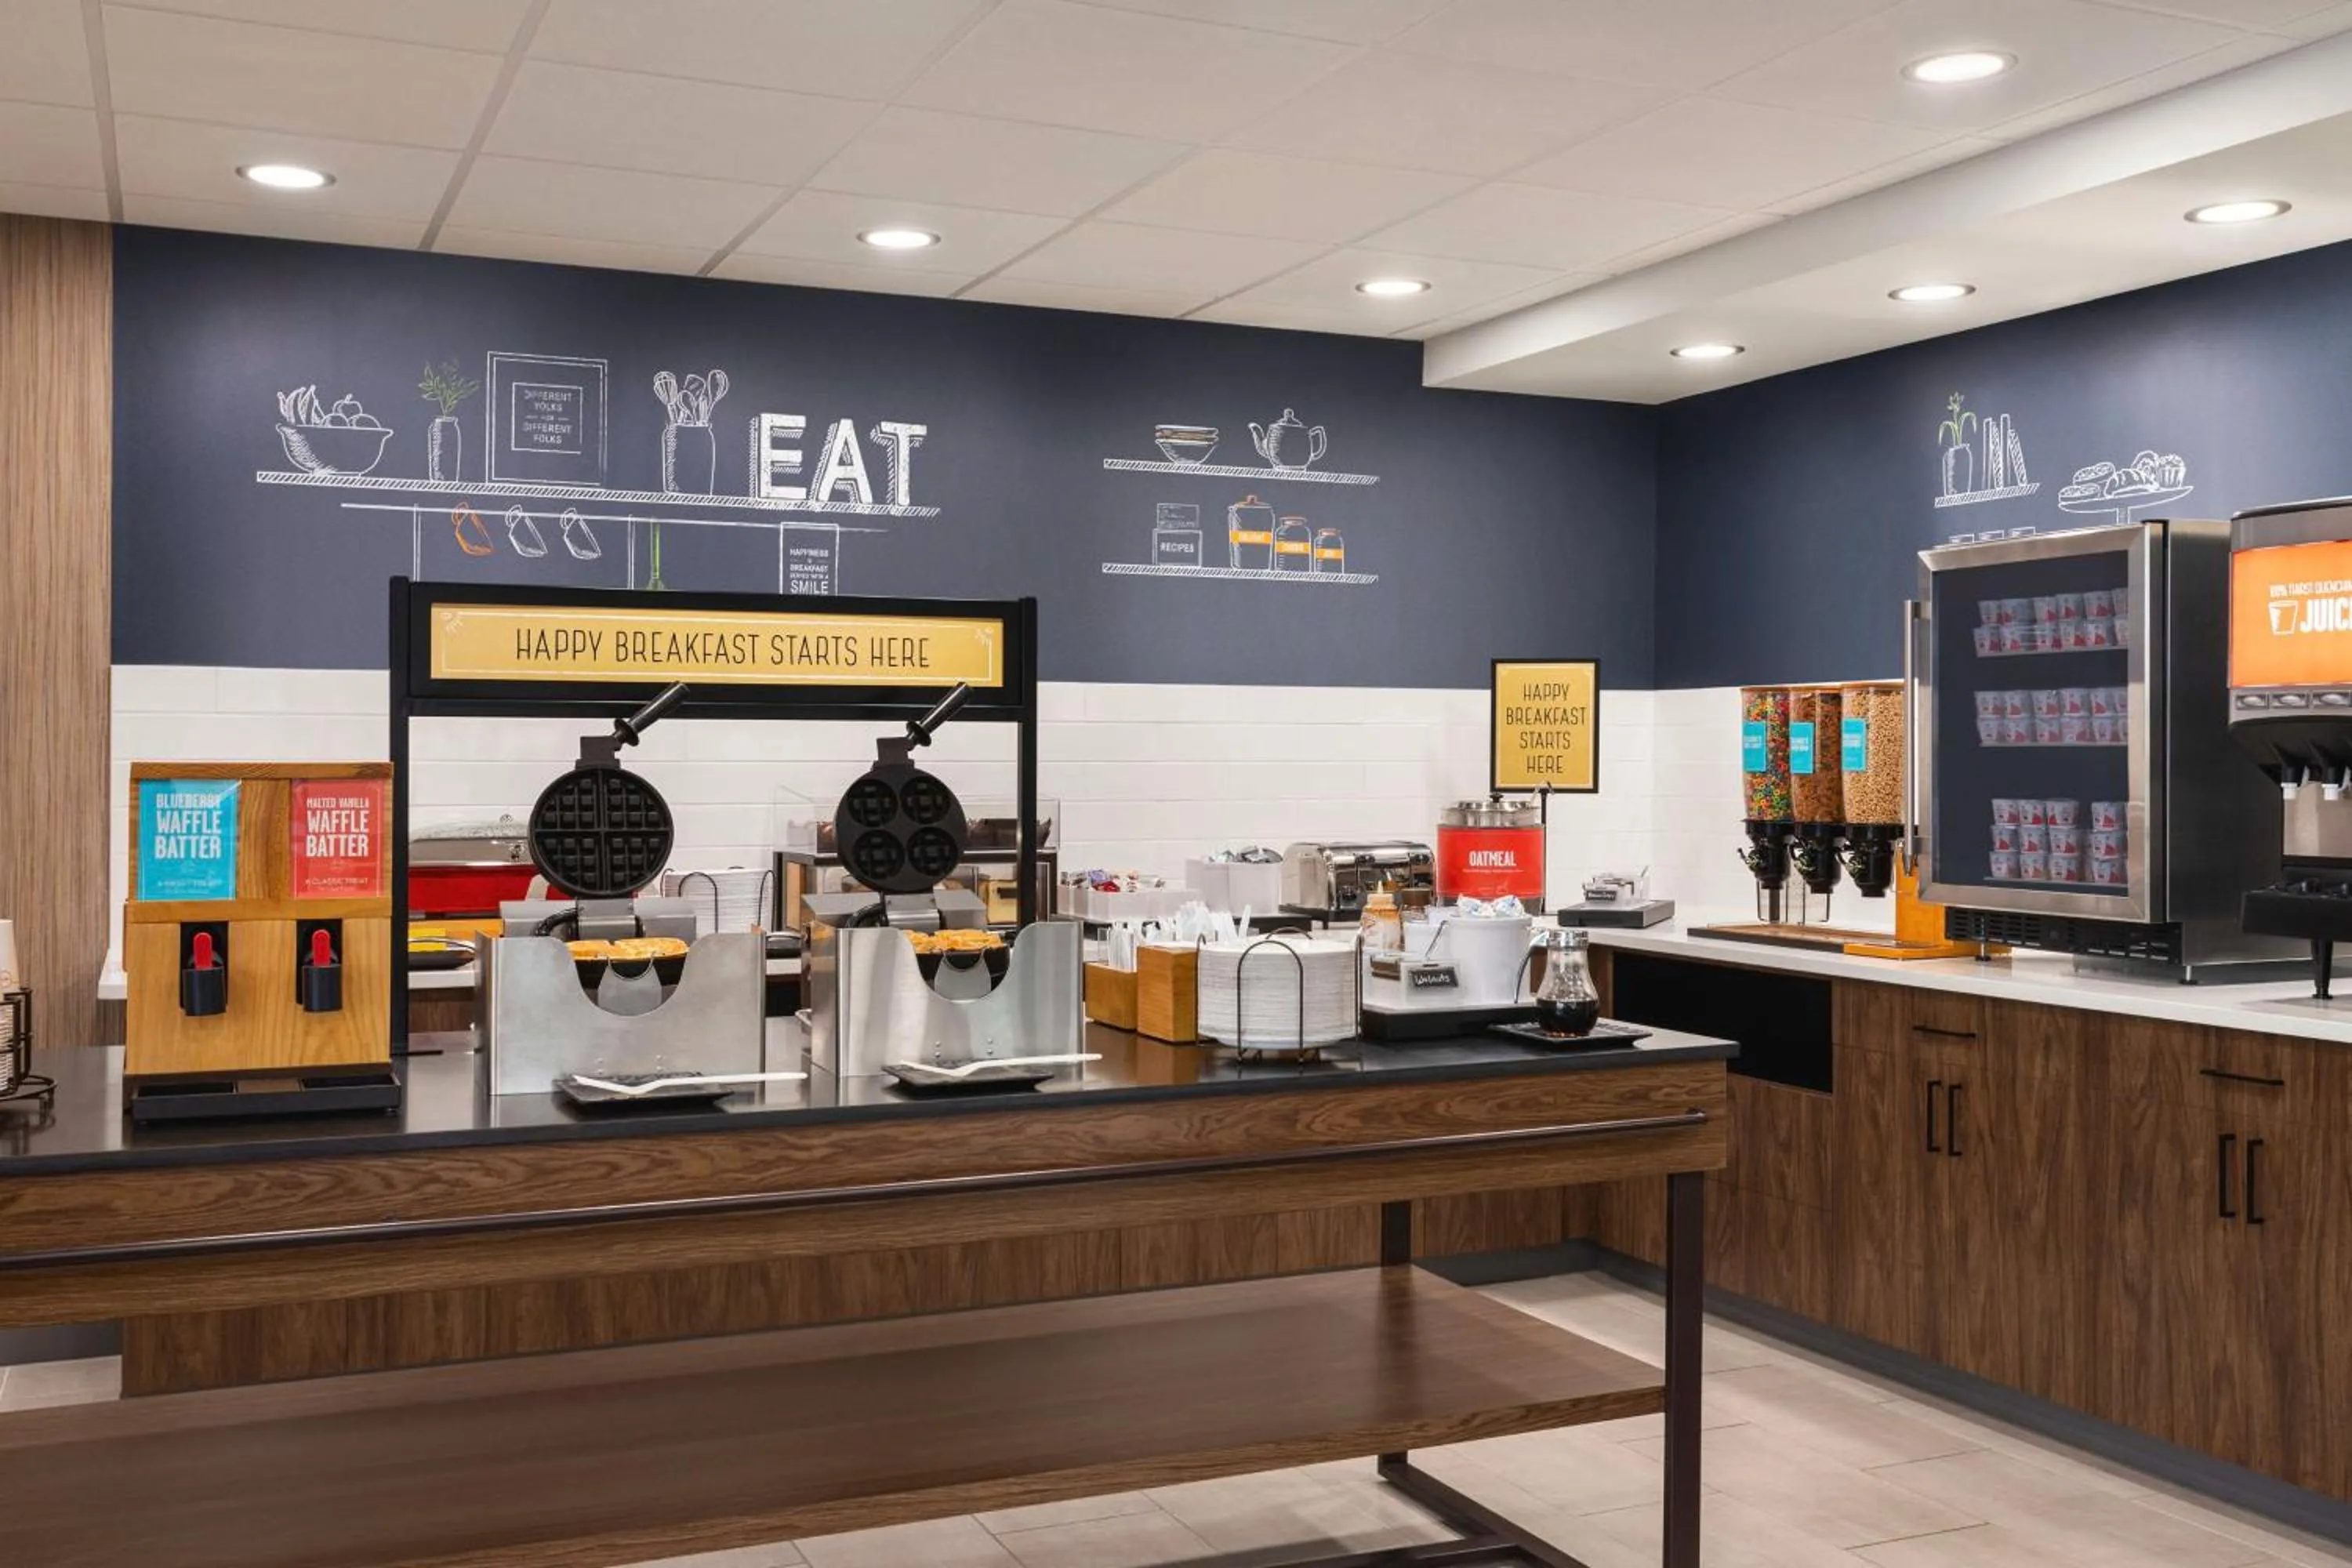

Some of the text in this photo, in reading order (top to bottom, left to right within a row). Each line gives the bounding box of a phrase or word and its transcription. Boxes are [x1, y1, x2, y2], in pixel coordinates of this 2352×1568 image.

[523, 422, 572, 434] DIFFERENT
[533, 434, 562, 444] FOLKS
[751, 413, 927, 507] EAT
[789, 548, 829, 557] HAPPINESS
[789, 564, 829, 572] BREAKFAST
[790, 579, 829, 595] SMILE
[2299, 597, 2352, 633] JUIC
[517, 628, 931, 668] HAPPY BREAKFAST STARTS HERE
[1523, 683, 1570, 702] HAPPY
[1506, 706, 1588, 726] BREAKFAST
[1519, 731, 1571, 750] STARTS
[1526, 755, 1564, 774] HERE
[156, 793, 221, 809] BLUEBERRY
[307, 797, 369, 808] MALTED VANILLA
[157, 810, 223, 834] WAFFLE
[307, 810, 370, 833] WAFFLE
[154, 835, 222, 859] BATTER
[306, 834, 369, 857] BATTER
[1468, 851, 1517, 866] OATMEAL
